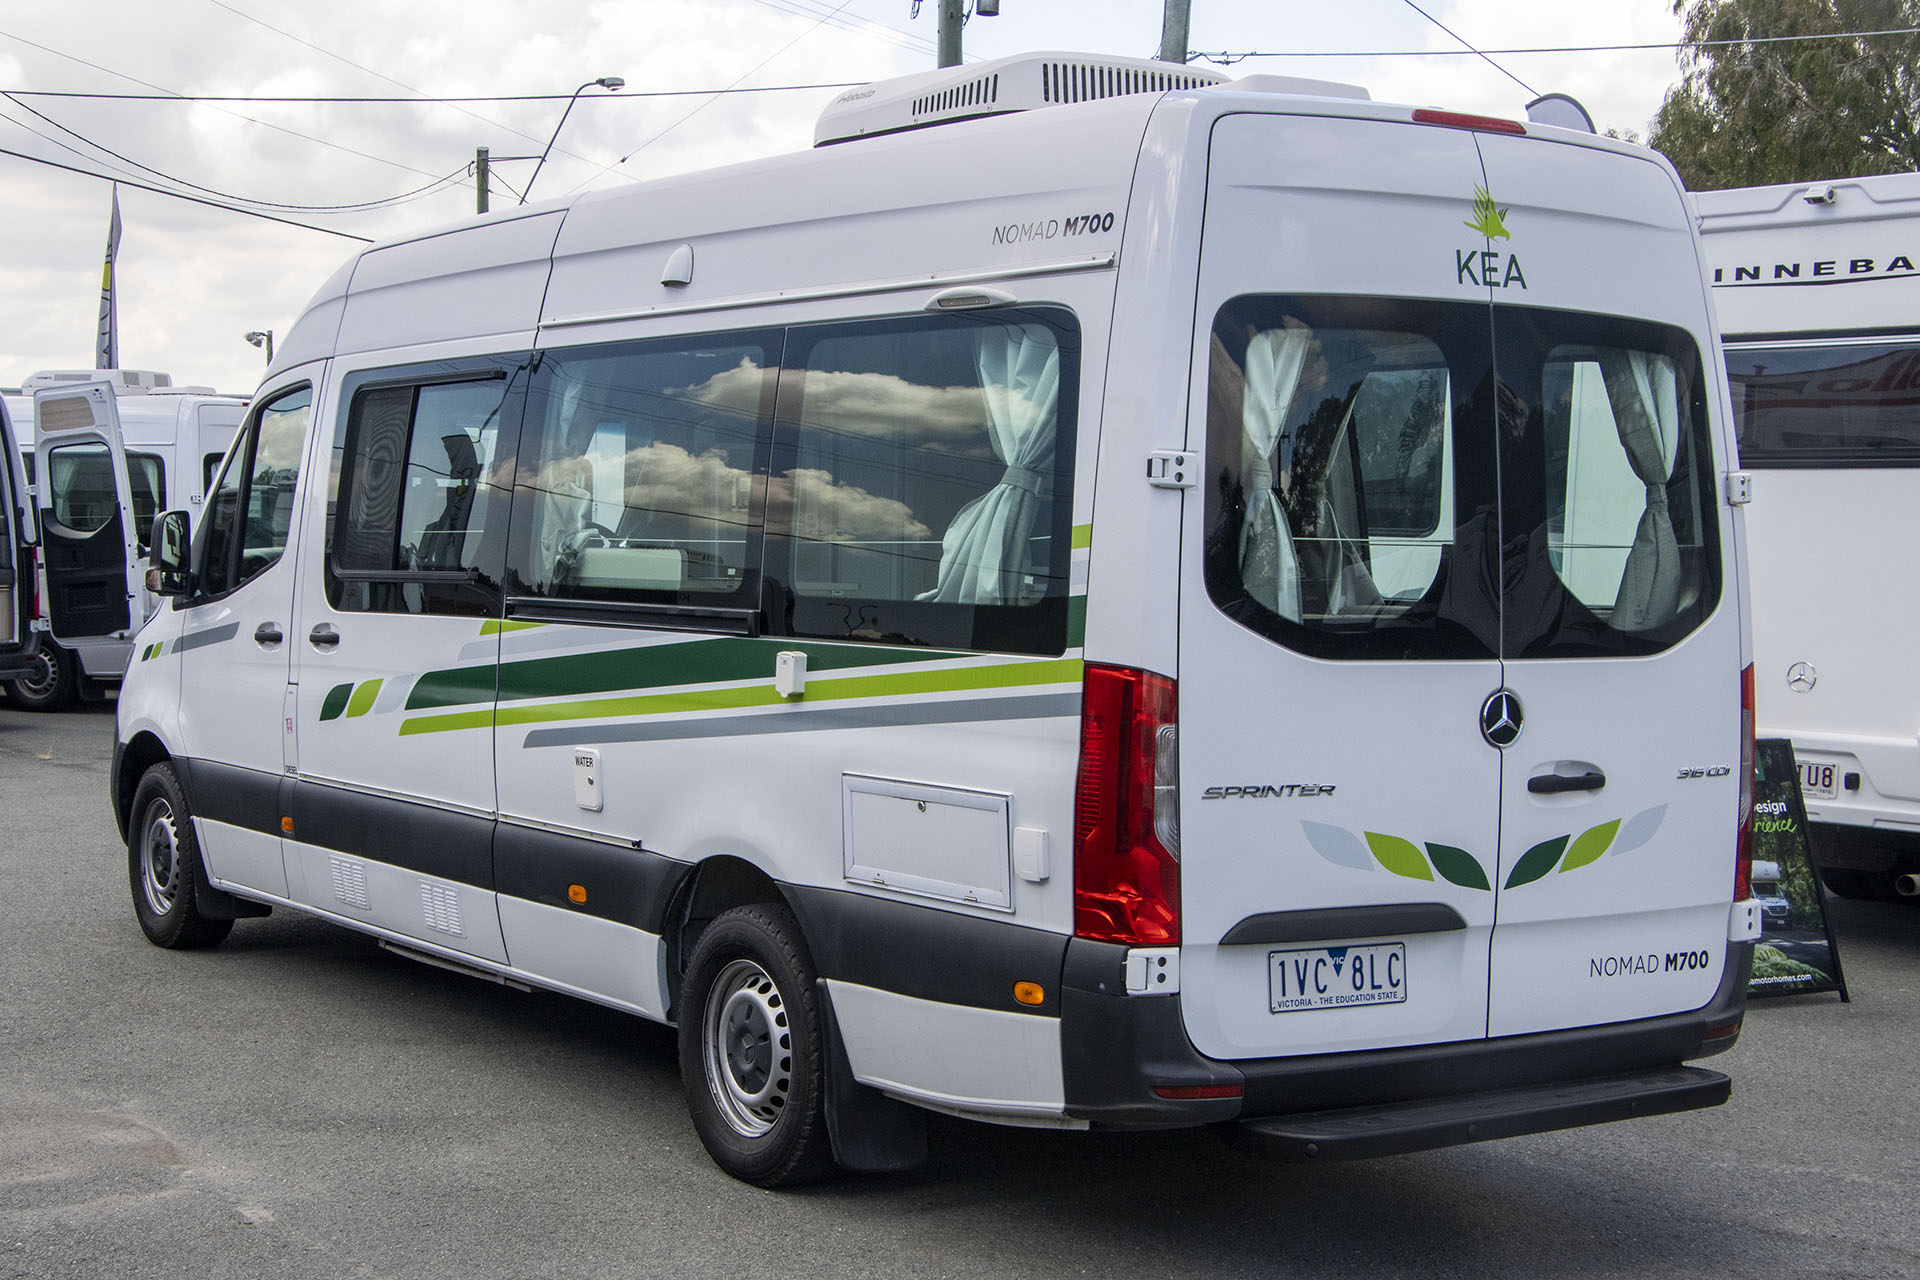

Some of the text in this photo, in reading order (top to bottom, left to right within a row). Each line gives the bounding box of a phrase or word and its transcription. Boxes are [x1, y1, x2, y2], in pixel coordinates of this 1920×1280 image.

[992, 211, 1115, 245] NOMAD M700
[1456, 249, 1528, 289] KEA
[1713, 256, 1916, 283] INNEBA
[574, 755, 594, 768] WATER
[1676, 767, 1705, 779] 316
[1201, 783, 1337, 801] SPRINTER
[1755, 800, 1787, 815] esign
[1590, 950, 1710, 977] NOMAD M700
[1278, 952, 1401, 997] 1VC 8LC
[1750, 974, 1812, 985] amotorhomes.com
[1277, 998, 1313, 1009] VICTORIA
[1319, 997, 1334, 1005] THE
[1335, 993, 1376, 1004] EDUCATION
[1377, 991, 1398, 1000] STATE
